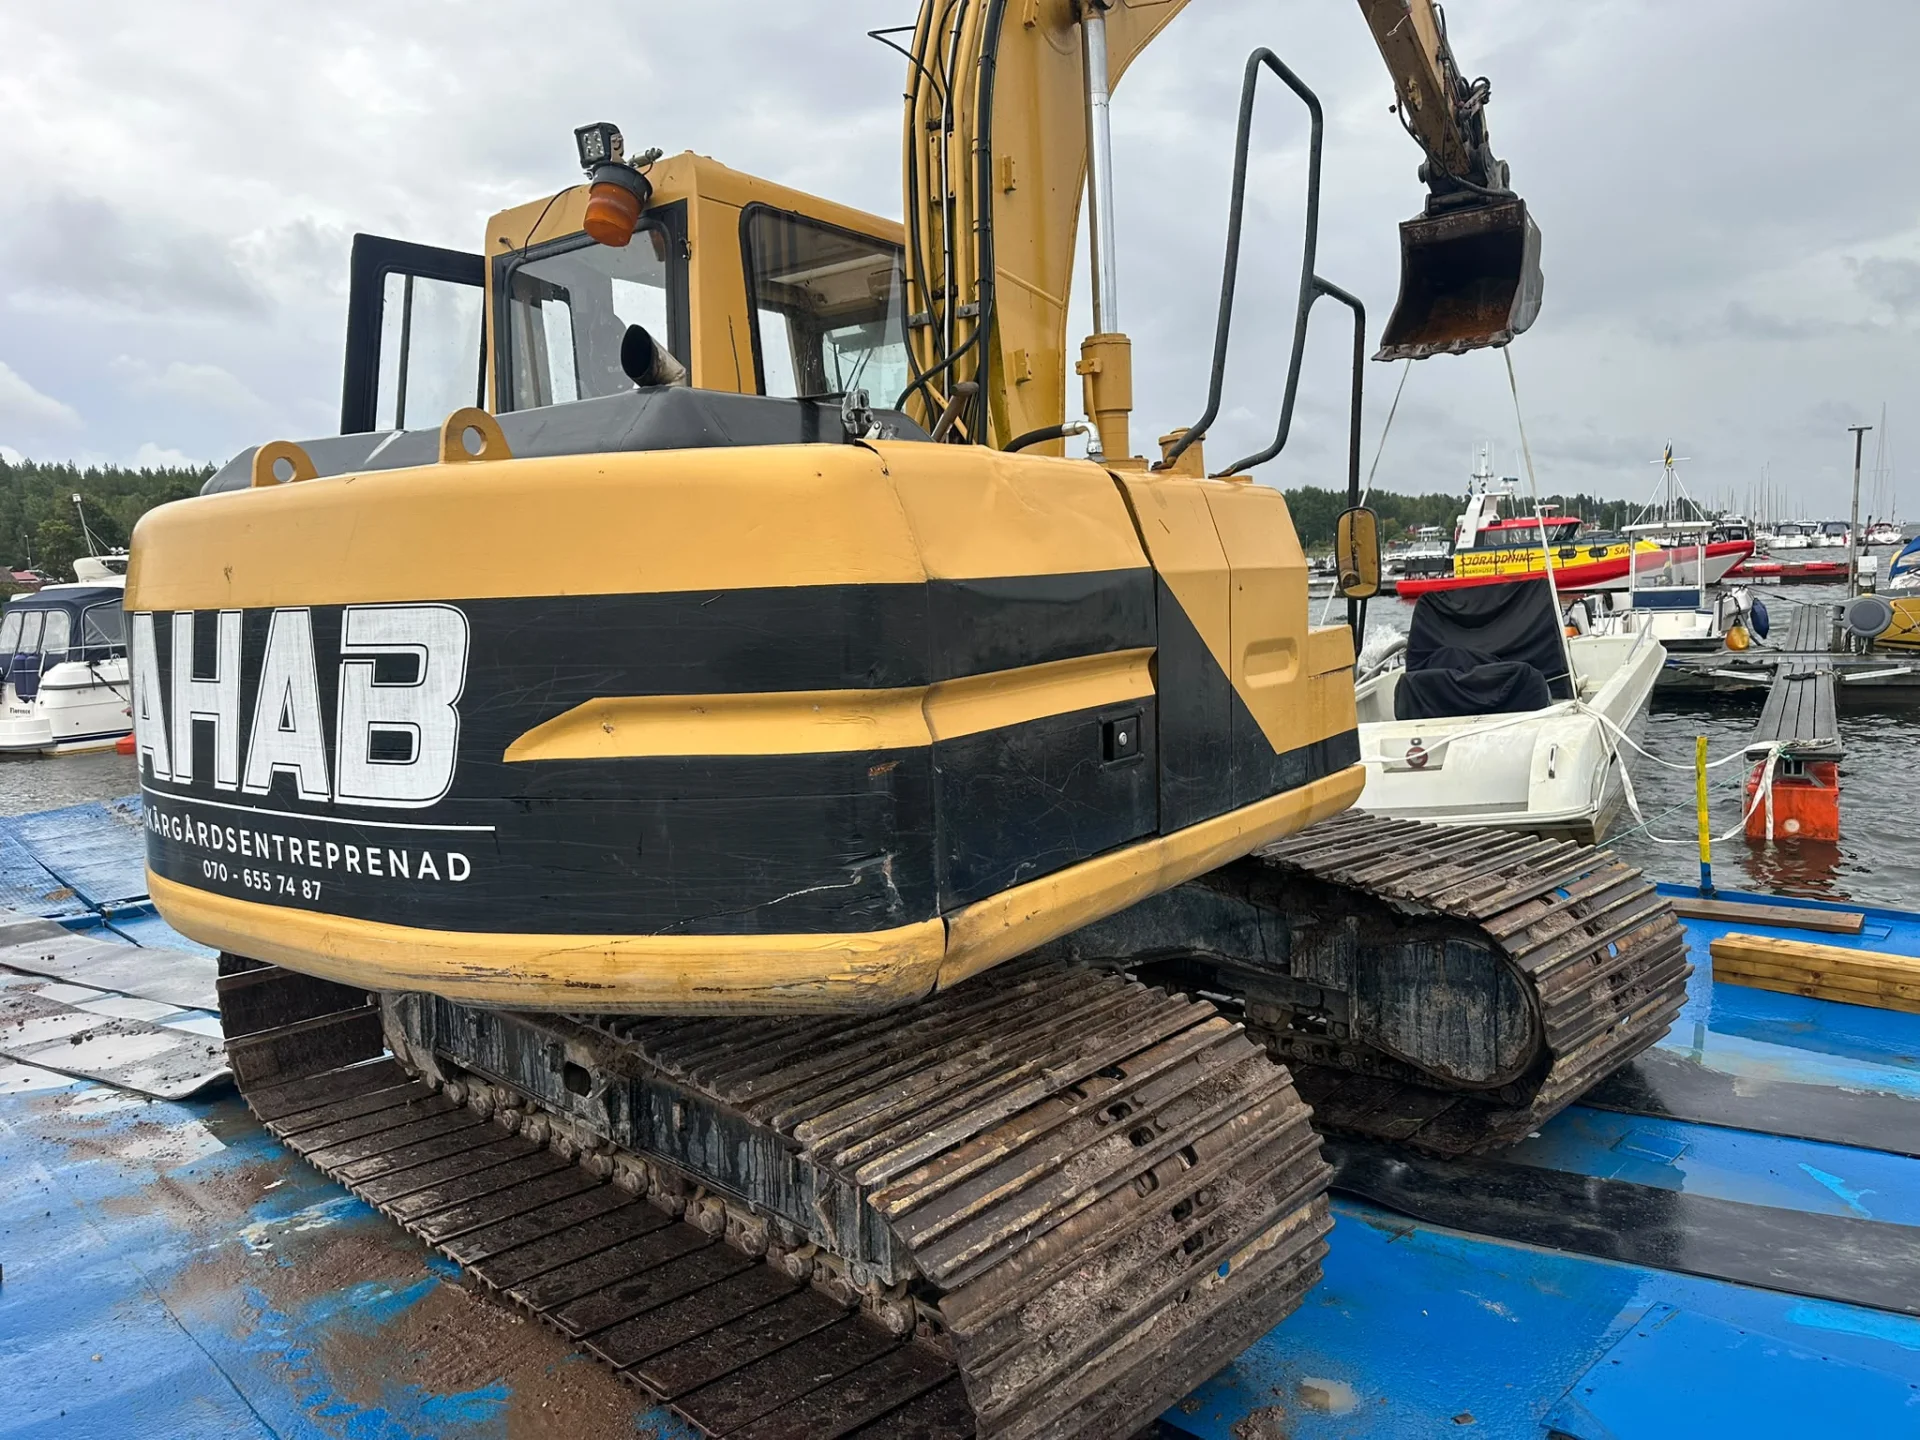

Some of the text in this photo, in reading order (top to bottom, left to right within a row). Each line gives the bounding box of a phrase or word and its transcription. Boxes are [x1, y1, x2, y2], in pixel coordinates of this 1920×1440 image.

[1460, 553, 1535, 566] SJÖRÄDDNING
[133, 603, 470, 808] AHAB
[203, 860, 227, 882] 070
[244, 868, 271, 891] 655
[276, 875, 297, 898] 74
[302, 879, 321, 900] 87
